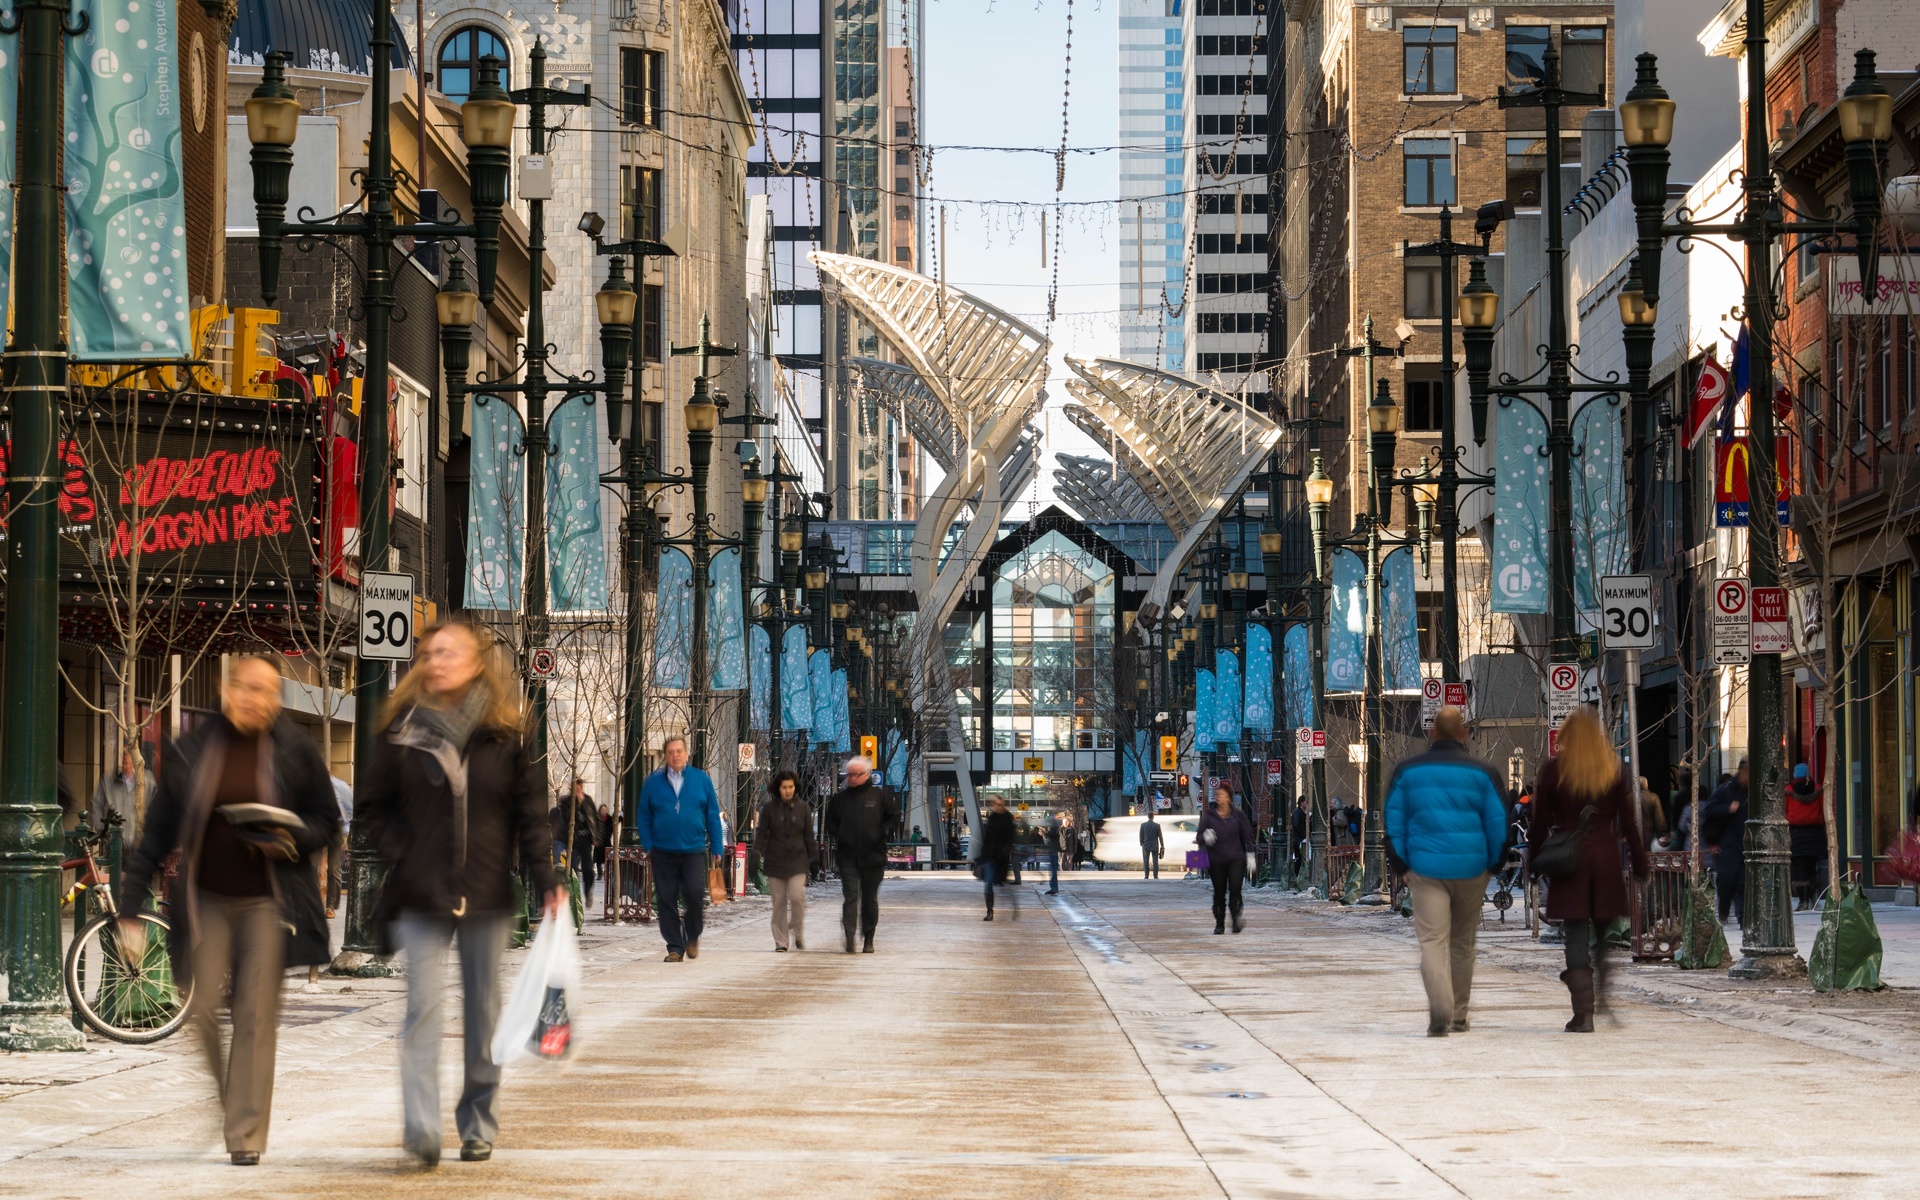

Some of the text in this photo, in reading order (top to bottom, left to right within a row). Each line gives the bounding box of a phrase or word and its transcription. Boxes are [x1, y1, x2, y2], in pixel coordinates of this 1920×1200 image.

[1771, 0, 1812, 55] BUILDING
[154, 0, 172, 116] Stephen Avenue
[1838, 274, 1906, 302] mago
[585, 420, 593, 438] Walk
[588, 466, 596, 494] Stephen
[1737, 510, 1750, 518] ope
[107, 496, 295, 559] MORGAN PAGE
[365, 587, 410, 602] MAXIMUM
[1604, 587, 1649, 599] MAXIMUM
[1759, 593, 1786, 604] TAXI
[1715, 615, 1748, 623] 06:00-18:00
[1759, 606, 1782, 617] ONLY
[363, 609, 409, 648] 30
[1604, 606, 1650, 637] 30
[1754, 634, 1788, 643] 18:00-06:00
[1447, 687, 1463, 695] TAXI
